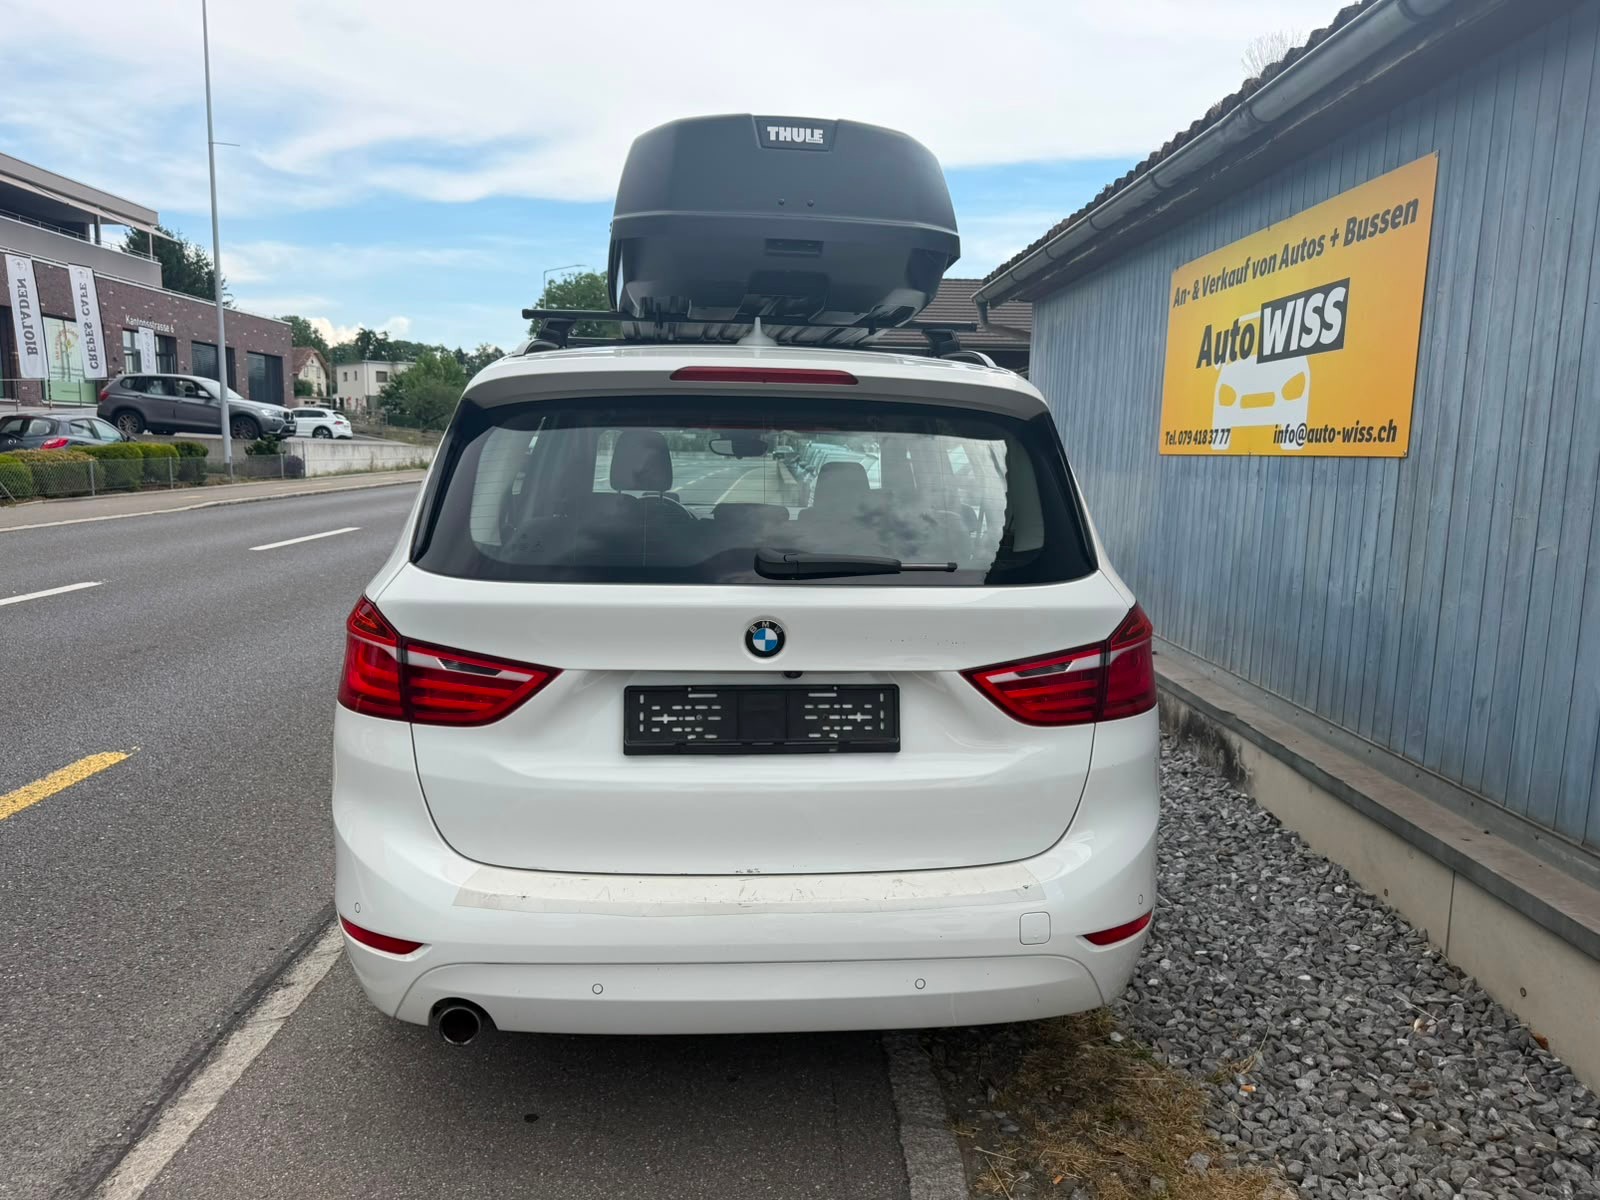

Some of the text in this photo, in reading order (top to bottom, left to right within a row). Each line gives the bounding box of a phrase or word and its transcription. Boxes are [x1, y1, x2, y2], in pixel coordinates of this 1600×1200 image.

[767, 126, 823, 144] THULE
[1173, 198, 1419, 308] An- & Verkauf von Autos + Bussen
[1165, 429, 1231, 445] Tel. 079 418 37 77
[1273, 419, 1398, 447] info@auto-wiss.ch
[750, 621, 782, 634] BMW
